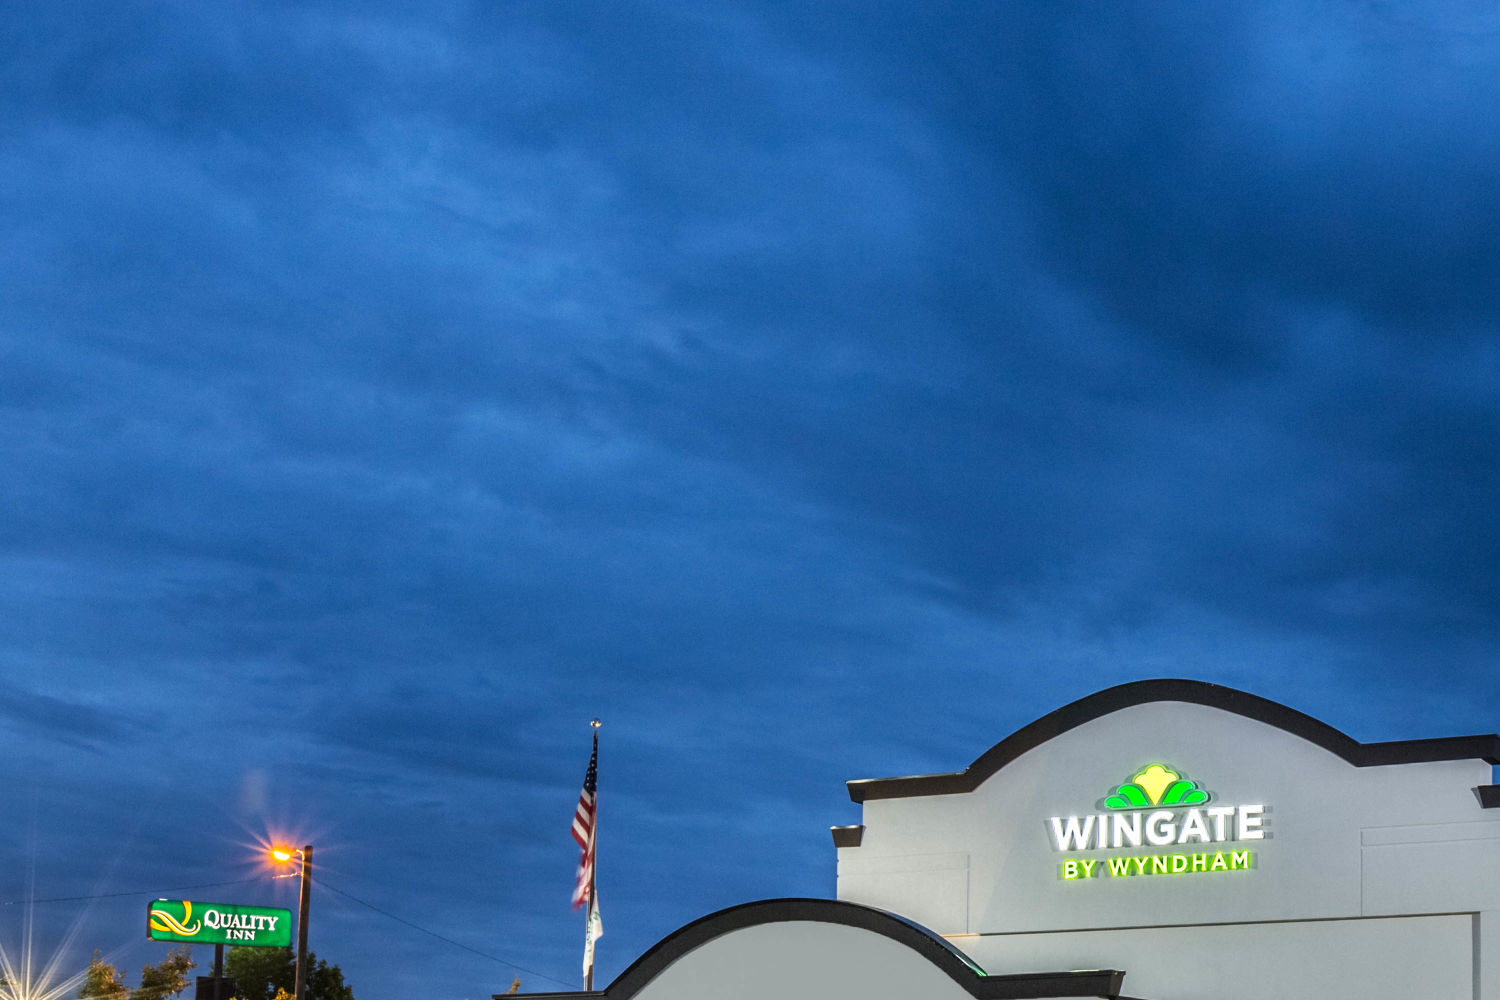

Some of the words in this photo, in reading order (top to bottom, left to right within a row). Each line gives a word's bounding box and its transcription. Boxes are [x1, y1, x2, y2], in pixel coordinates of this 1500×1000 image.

[1051, 804, 1264, 851] WINGATE
[1063, 859, 1096, 880] BY
[1108, 850, 1249, 877] WYNDHAM
[204, 909, 279, 931] QUALITY
[225, 929, 256, 941] INN
